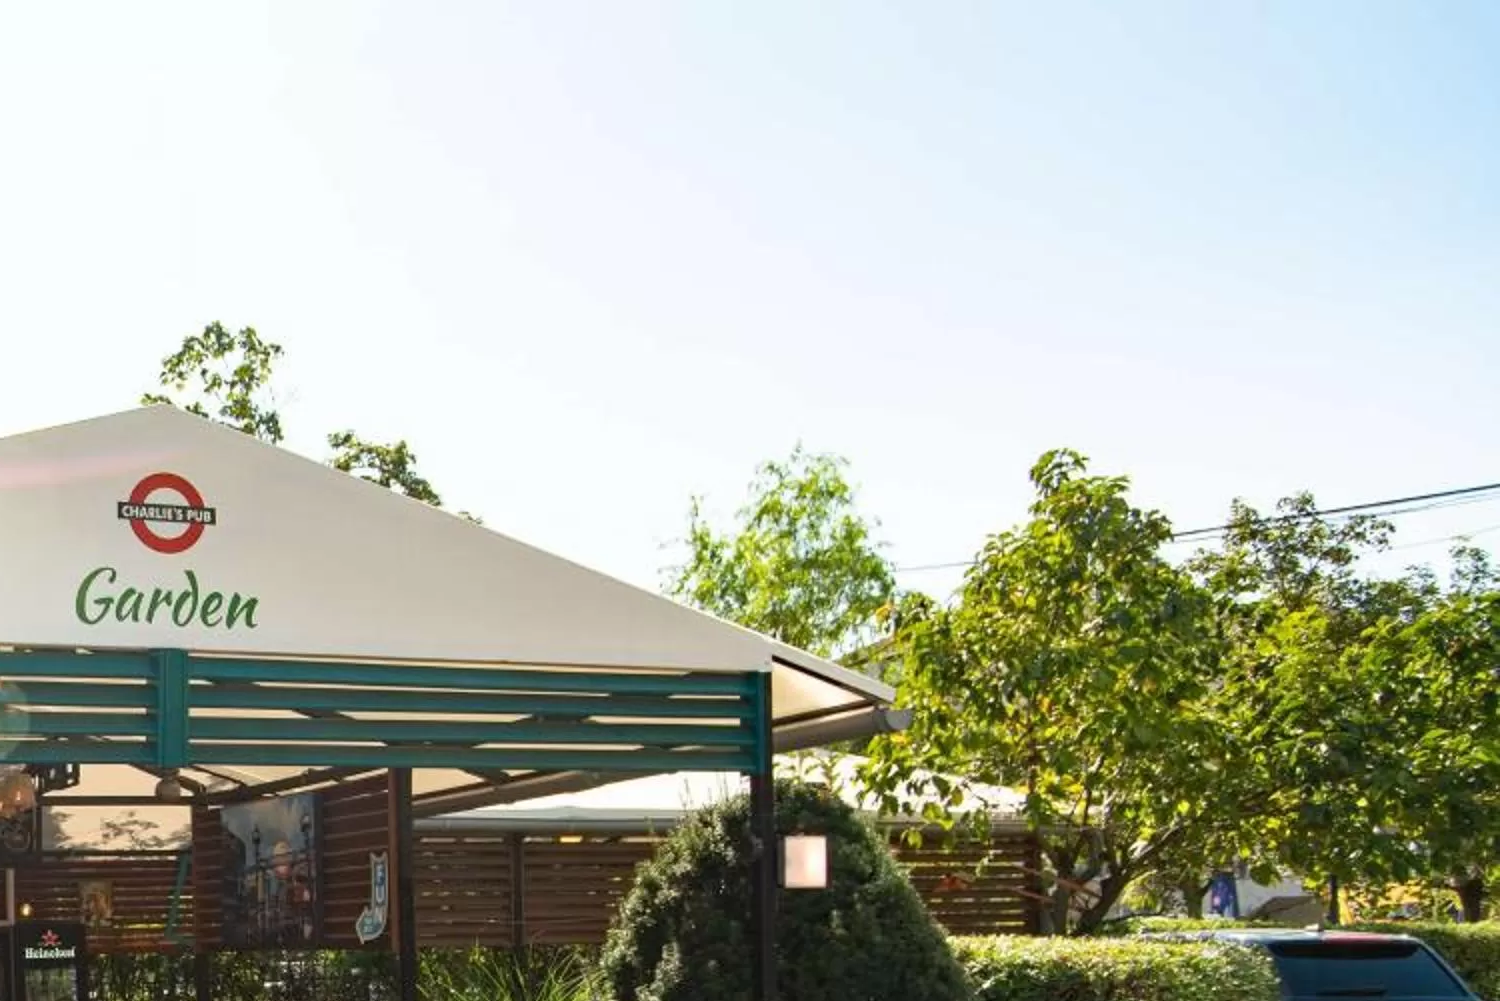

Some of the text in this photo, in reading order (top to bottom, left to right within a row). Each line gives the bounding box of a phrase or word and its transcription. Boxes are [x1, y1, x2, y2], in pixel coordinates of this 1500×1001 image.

[122, 505, 212, 523] CHARLIE'S PUB
[75, 567, 260, 630] Garden
